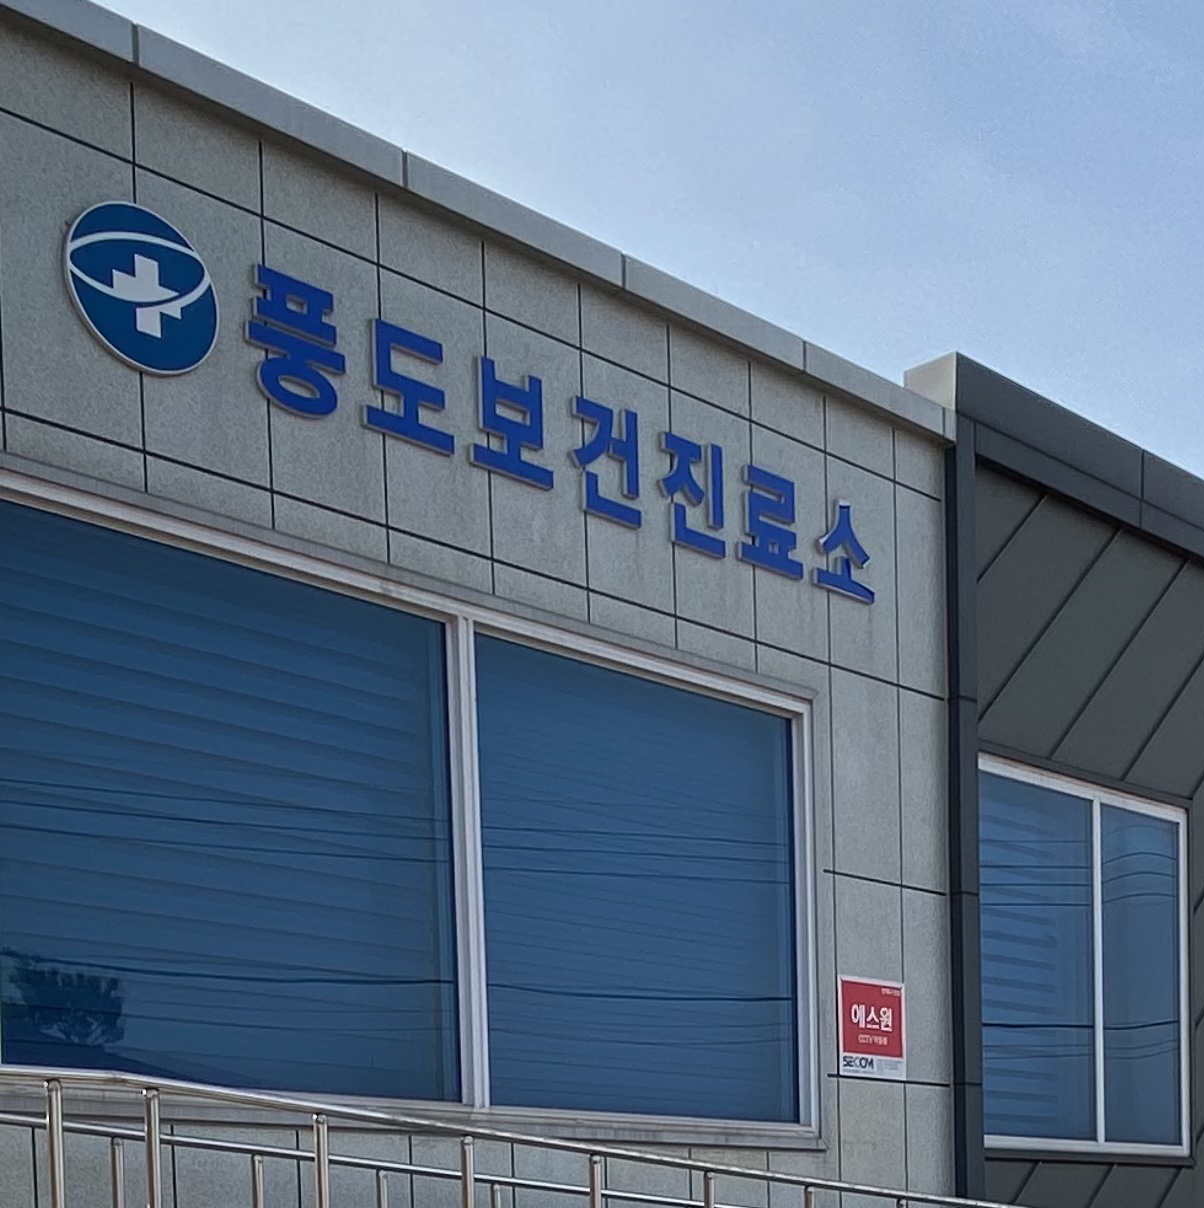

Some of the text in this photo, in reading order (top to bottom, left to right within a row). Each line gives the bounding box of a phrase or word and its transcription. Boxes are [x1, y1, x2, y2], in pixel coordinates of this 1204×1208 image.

[246, 263, 876, 604] 풍도보건진료소
[851, 1004, 892, 1032] 에스원
[843, 1056, 874, 1069] SECOM
